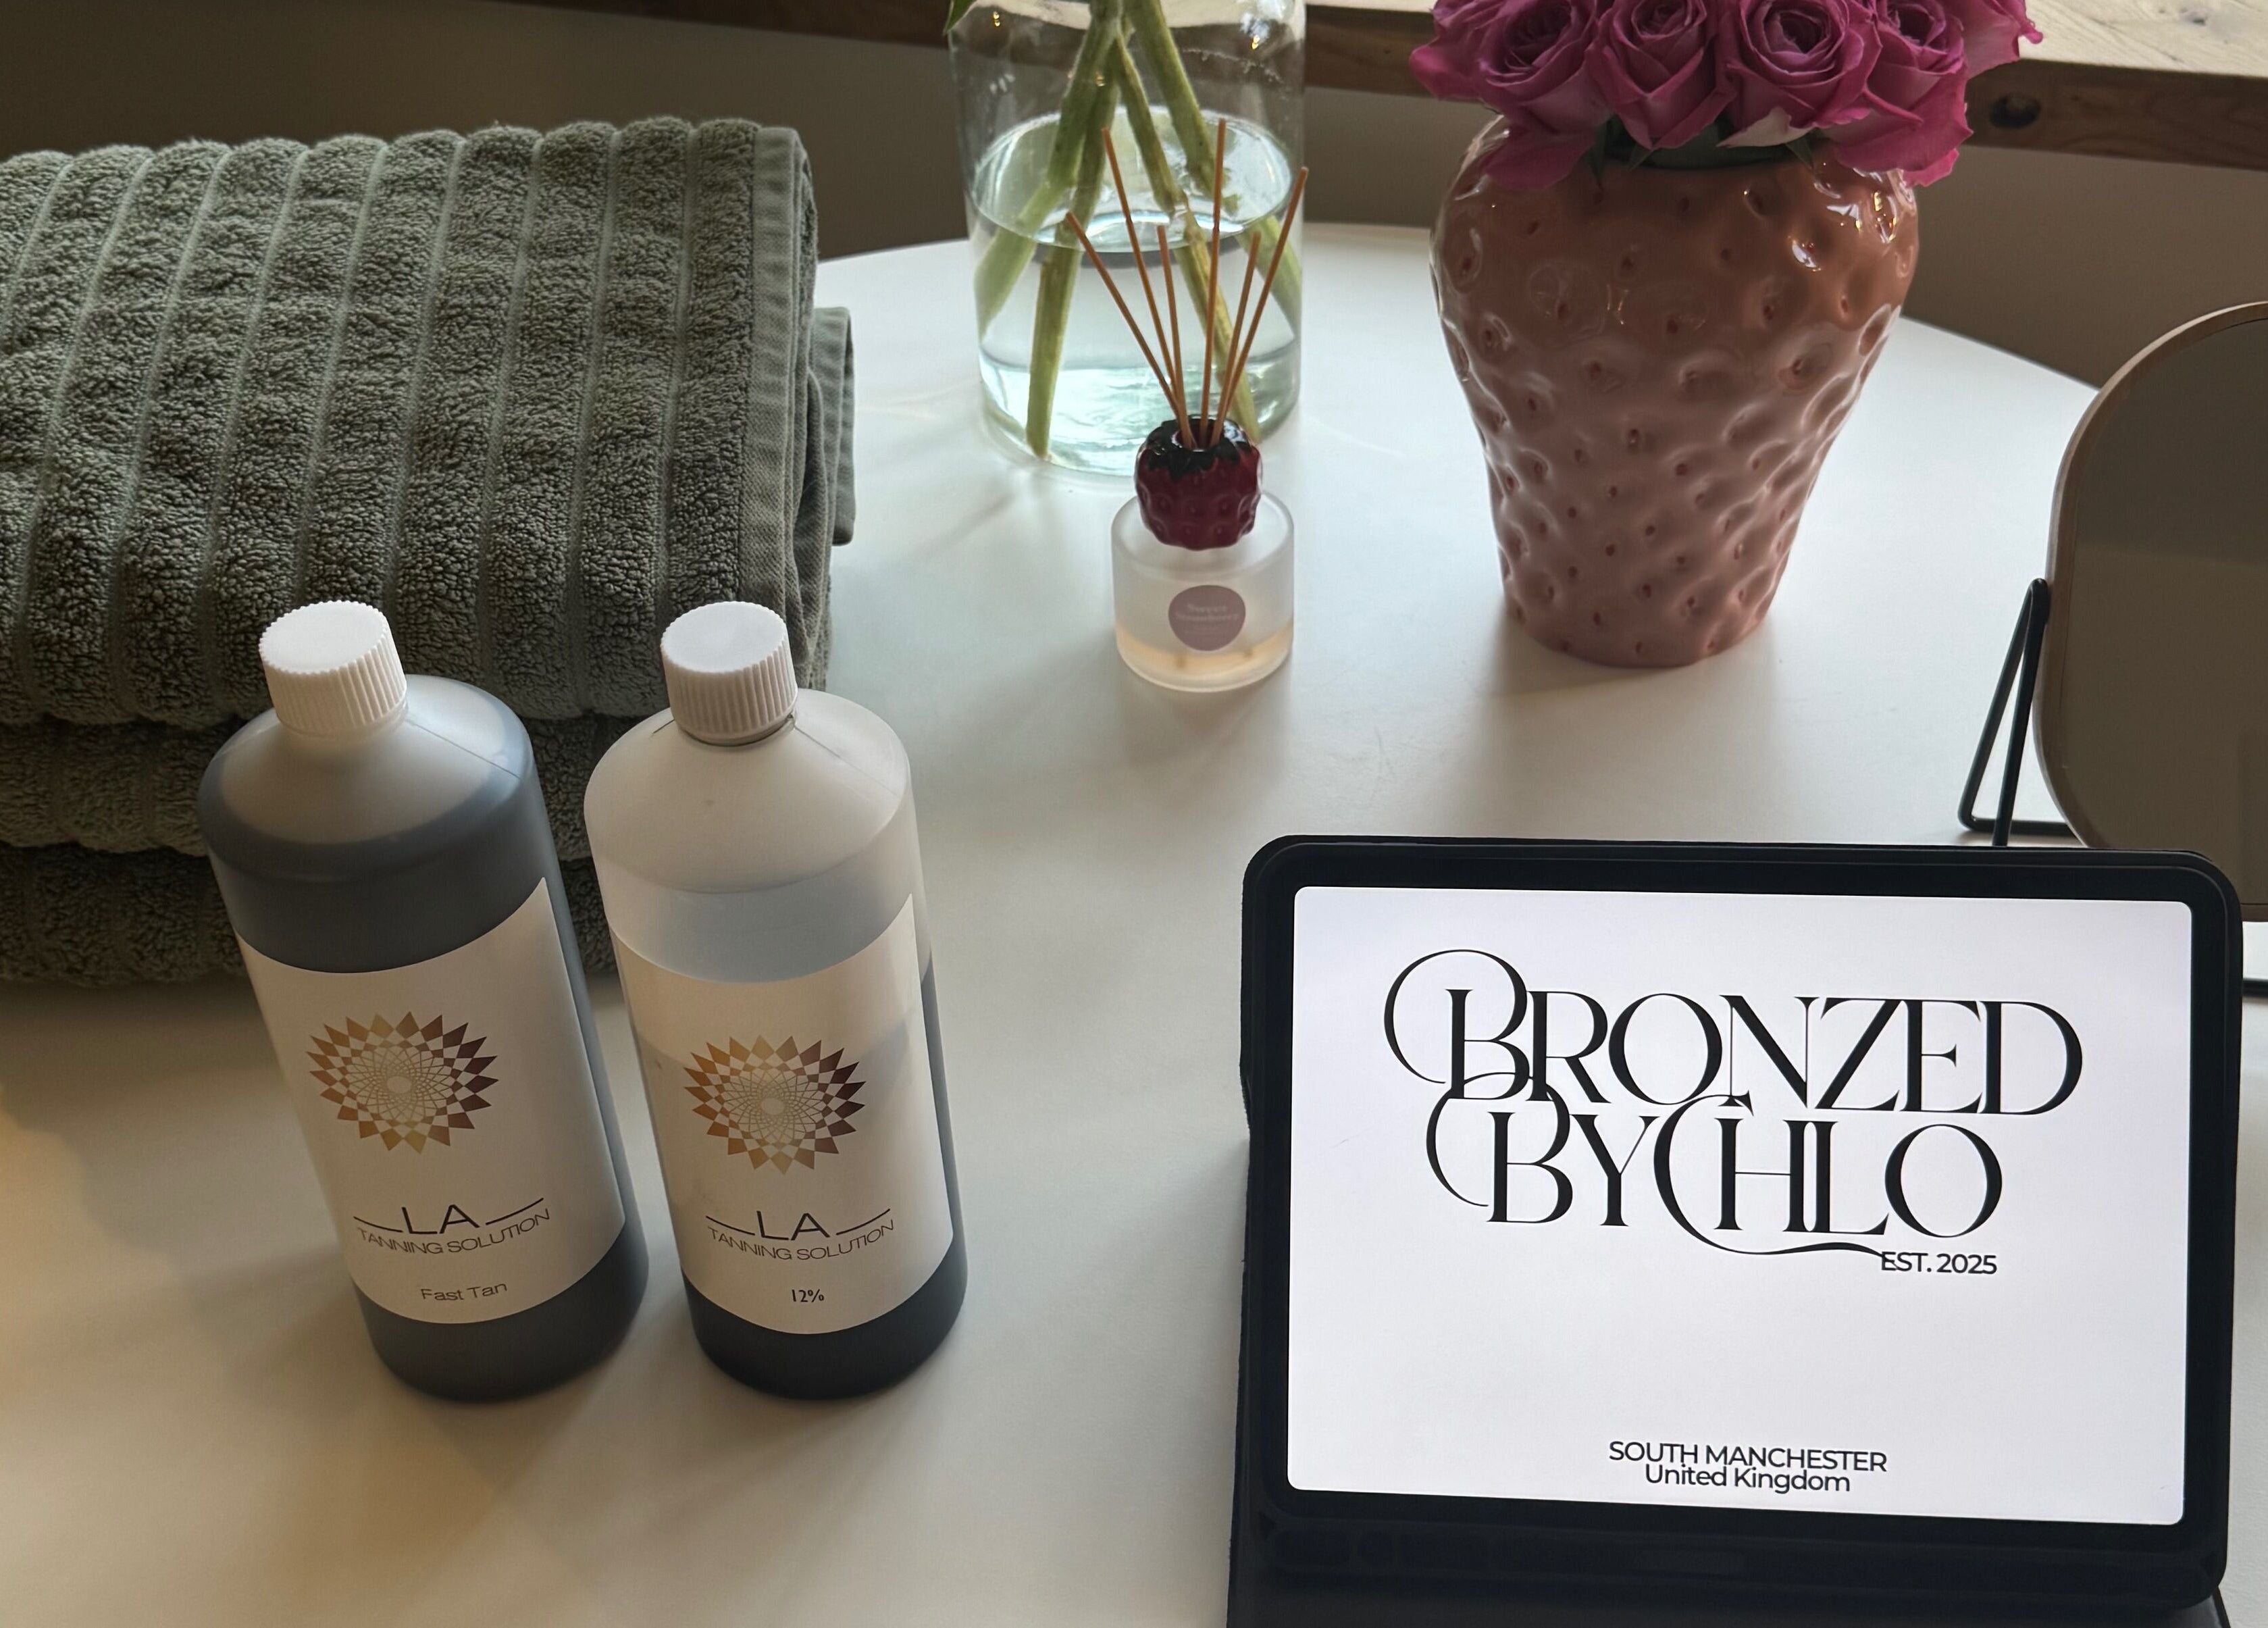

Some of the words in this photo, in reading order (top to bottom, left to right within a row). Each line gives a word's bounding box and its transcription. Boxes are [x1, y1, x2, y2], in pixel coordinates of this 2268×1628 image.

[1384, 949, 2082, 1115] BRONZED
[357, 1227, 444, 1254] TANNING
[446, 1208, 550, 1252] SOLUTION
[401, 1204, 480, 1234] LA
[756, 1211, 830, 1241] LA
[708, 1227, 792, 1260] TANNING
[796, 1219, 894, 1261] SOLUTION
[1881, 1251, 1932, 1273] EST.
[1936, 1253, 1997, 1274] 2025
[420, 1288, 465, 1301] Fast
[467, 1283, 508, 1299] Tan
[792, 1288, 825, 1303] 12%
[1609, 1441, 1698, 1464] SOUTH
[1705, 1444, 1887, 1472] MANCHESTER
[1645, 1463, 1727, 1487] United
[1734, 1467, 1851, 1495] Kingdom
